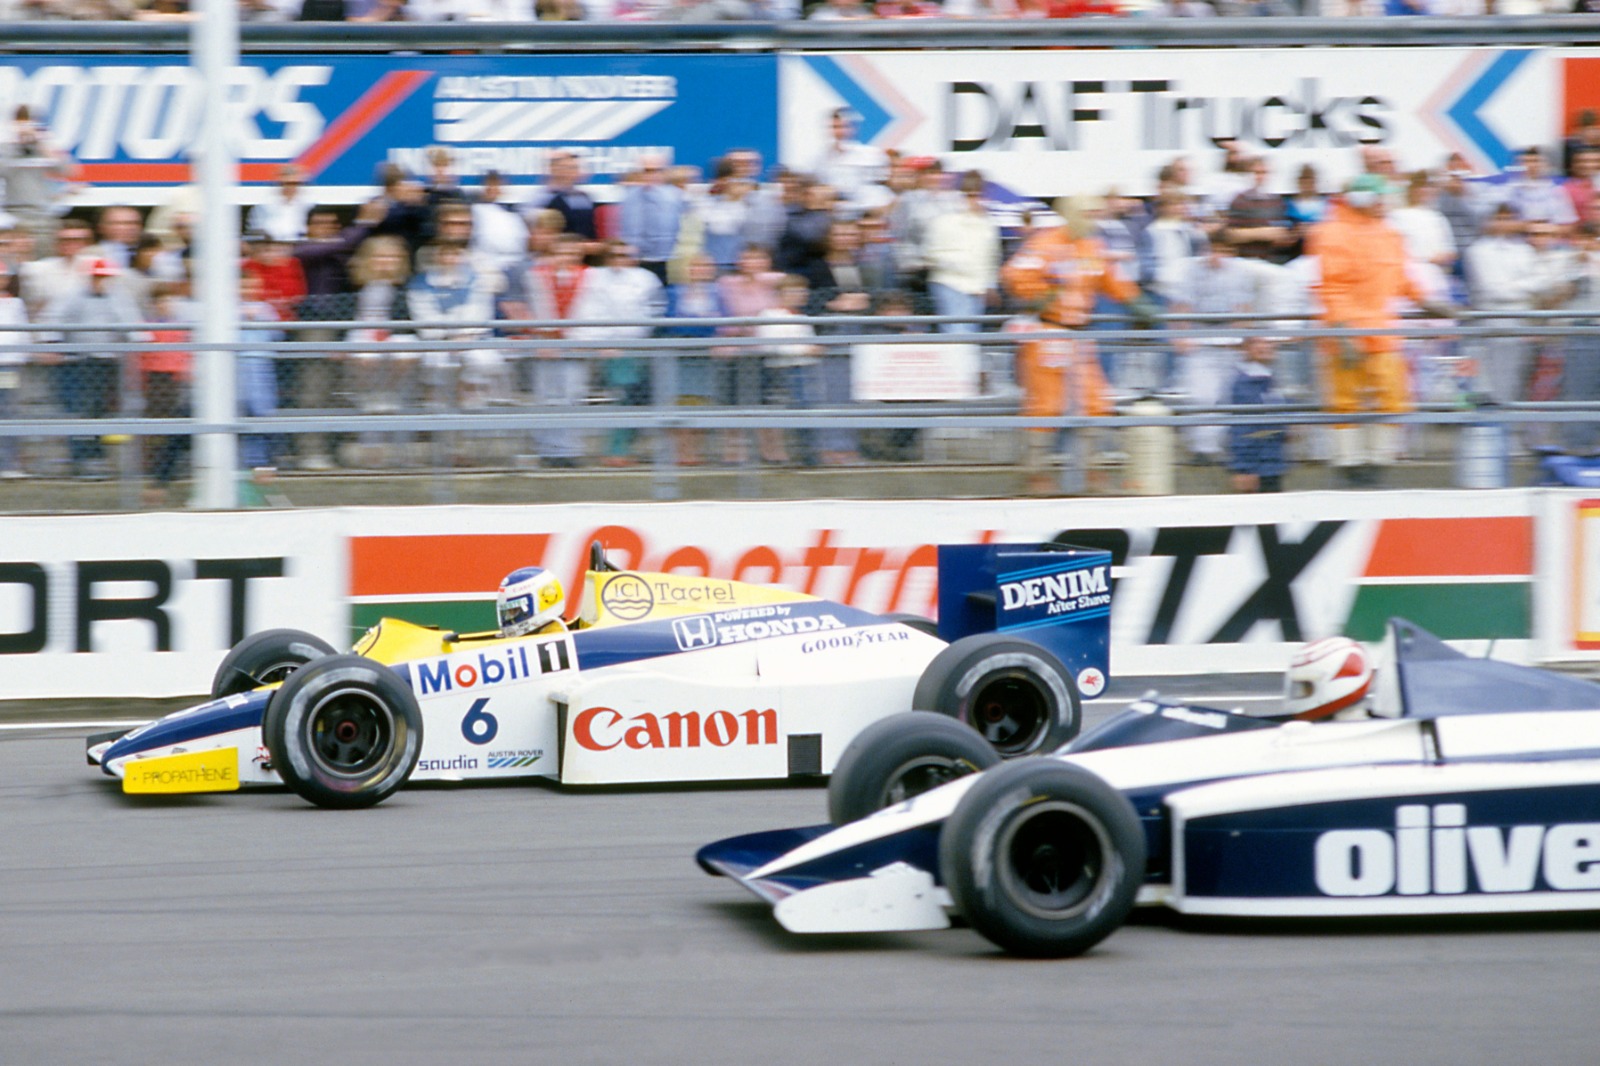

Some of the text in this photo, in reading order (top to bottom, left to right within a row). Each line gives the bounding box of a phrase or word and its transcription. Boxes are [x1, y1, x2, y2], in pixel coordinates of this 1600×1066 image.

[940, 77, 1396, 151] DAF Trucks
[614, 582, 640, 598] ICI
[655, 582, 736, 603] Tactel
[1000, 566, 1108, 610] DENIM
[715, 606, 792, 623] POWERED by
[1047, 594, 1110, 614] After Shave
[717, 614, 846, 645] HONDA
[418, 640, 565, 694] Mobil 1
[461, 697, 498, 745] 6
[573, 707, 778, 752] Canon
[418, 755, 478, 771] saudia
[488, 749, 544, 758] AUSTIN ROVER
[142, 767, 233, 785] PROPATHENE
[1315, 803, 1600, 897] olive
